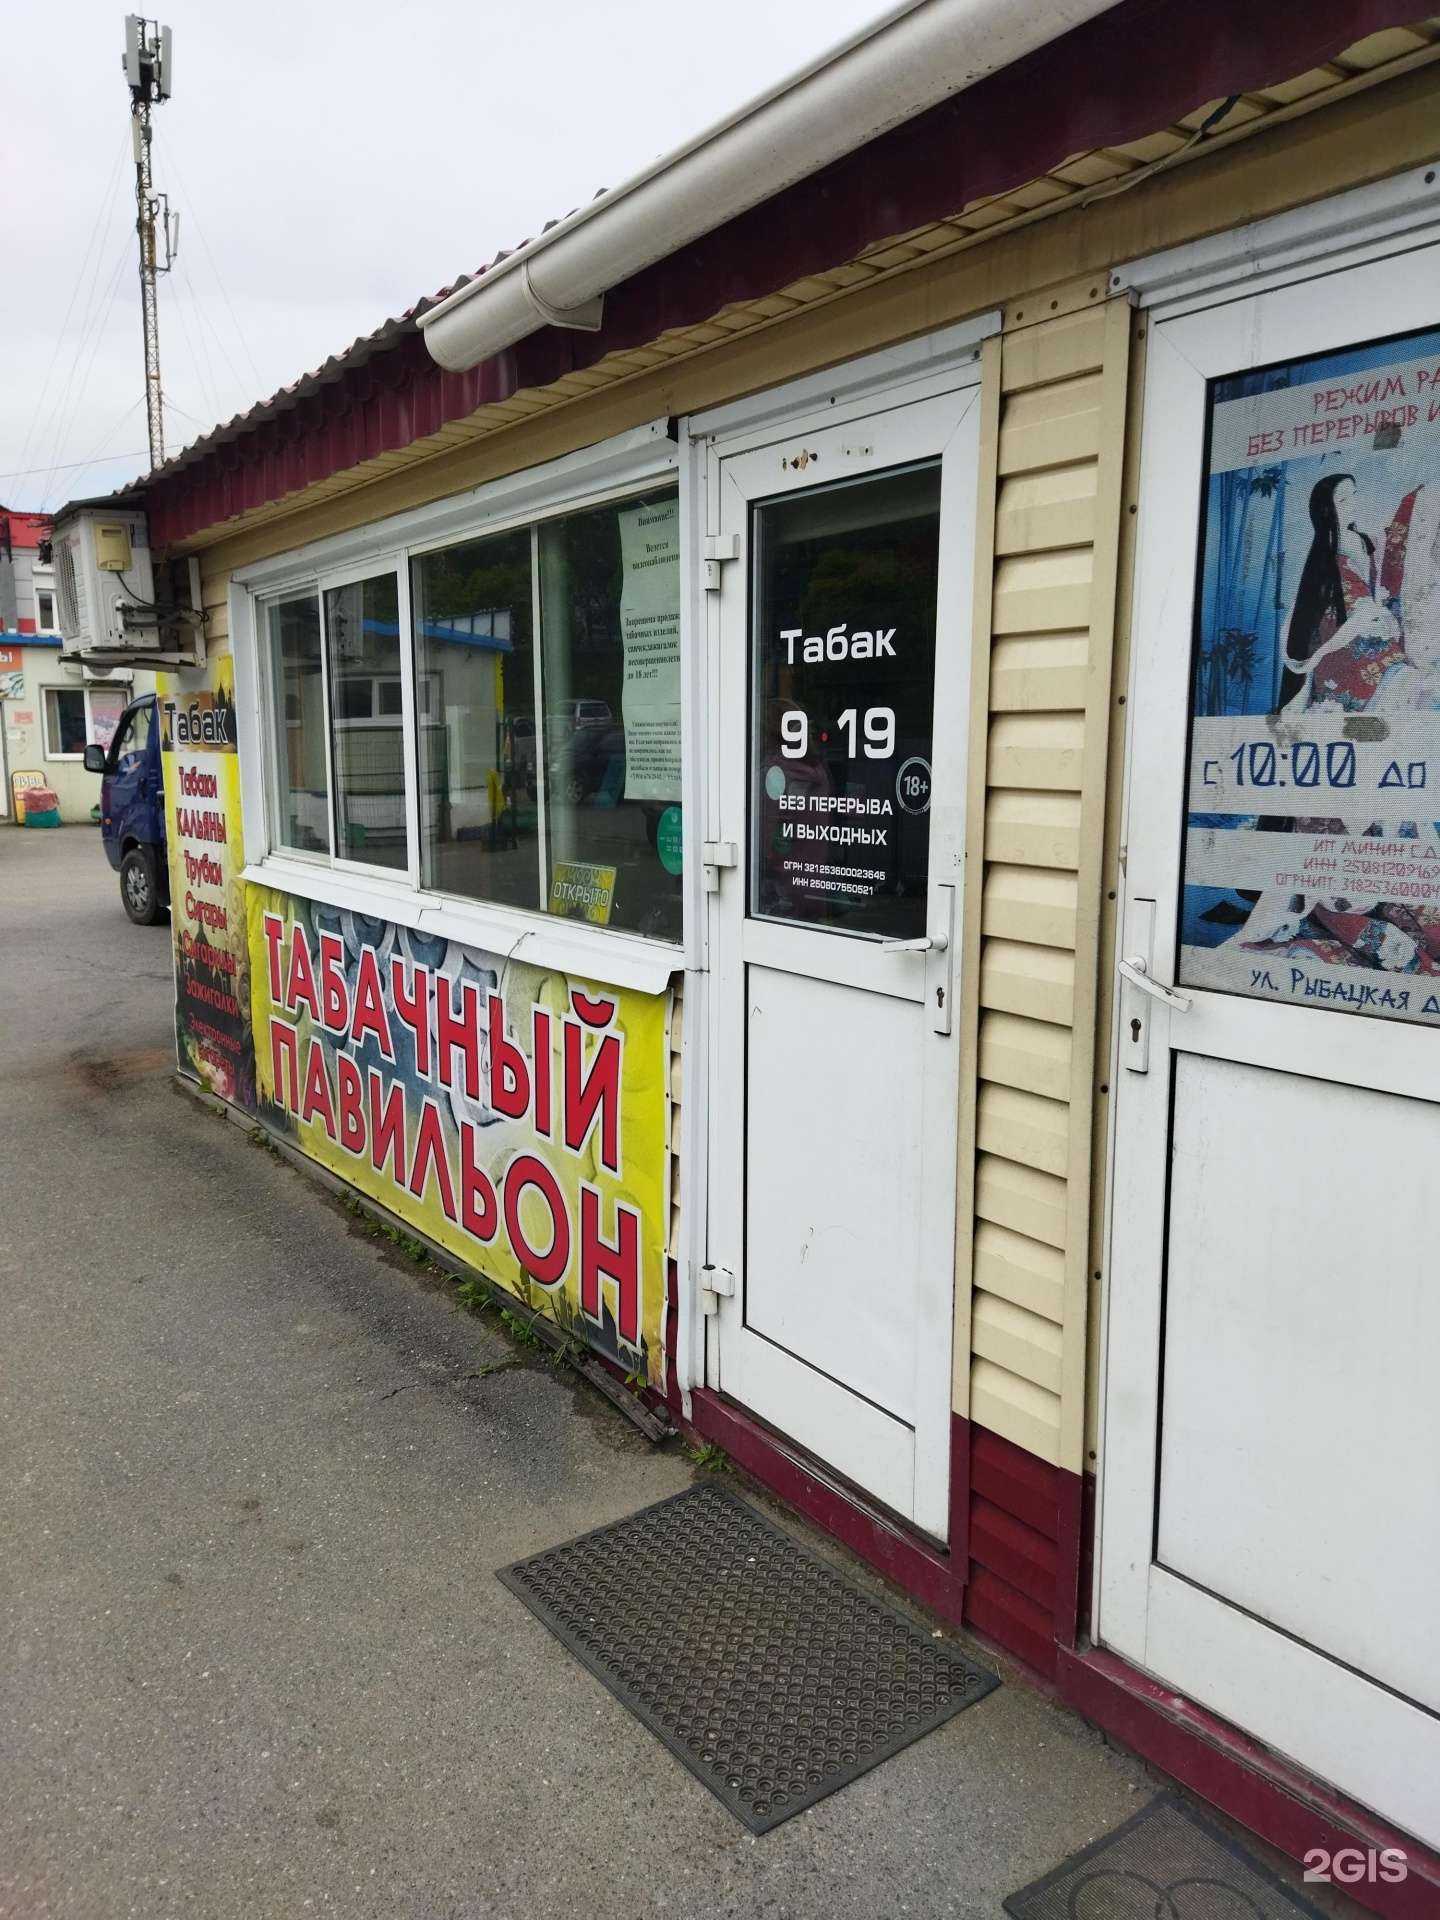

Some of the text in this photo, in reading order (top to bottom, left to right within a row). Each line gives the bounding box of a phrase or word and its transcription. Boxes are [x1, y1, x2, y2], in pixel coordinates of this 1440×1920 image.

[1313, 375, 1406, 415] РЕЖИМ
[1247, 430, 1283, 456] БЕЗ
[780, 624, 897, 665] Табак
[163, 701, 229, 745] Табак
[780, 707, 896, 759] 9 19
[178, 766, 218, 799] Табаки
[1230, 741, 1357, 788] 10:00
[904, 776, 928, 797] 18+
[779, 796, 893, 816] БЕЗ ПЕРЕРЫВА
[176, 807, 227, 844] КАЛЬЯНЫ
[782, 824, 888, 846] И ВЫХОДНЫХ
[184, 850, 223, 887] Трубки
[783, 861, 886, 880] ОГРН 321253600023645
[792, 877, 874, 896] ИНН 250807550521
[185, 890, 228, 936] Сигары
[553, 882, 610, 907] ОТКРЫТО
[264, 914, 622, 1177] ТАБАЧНЫЙ
[270, 1018, 640, 1350] ПАВИЛЬОН
